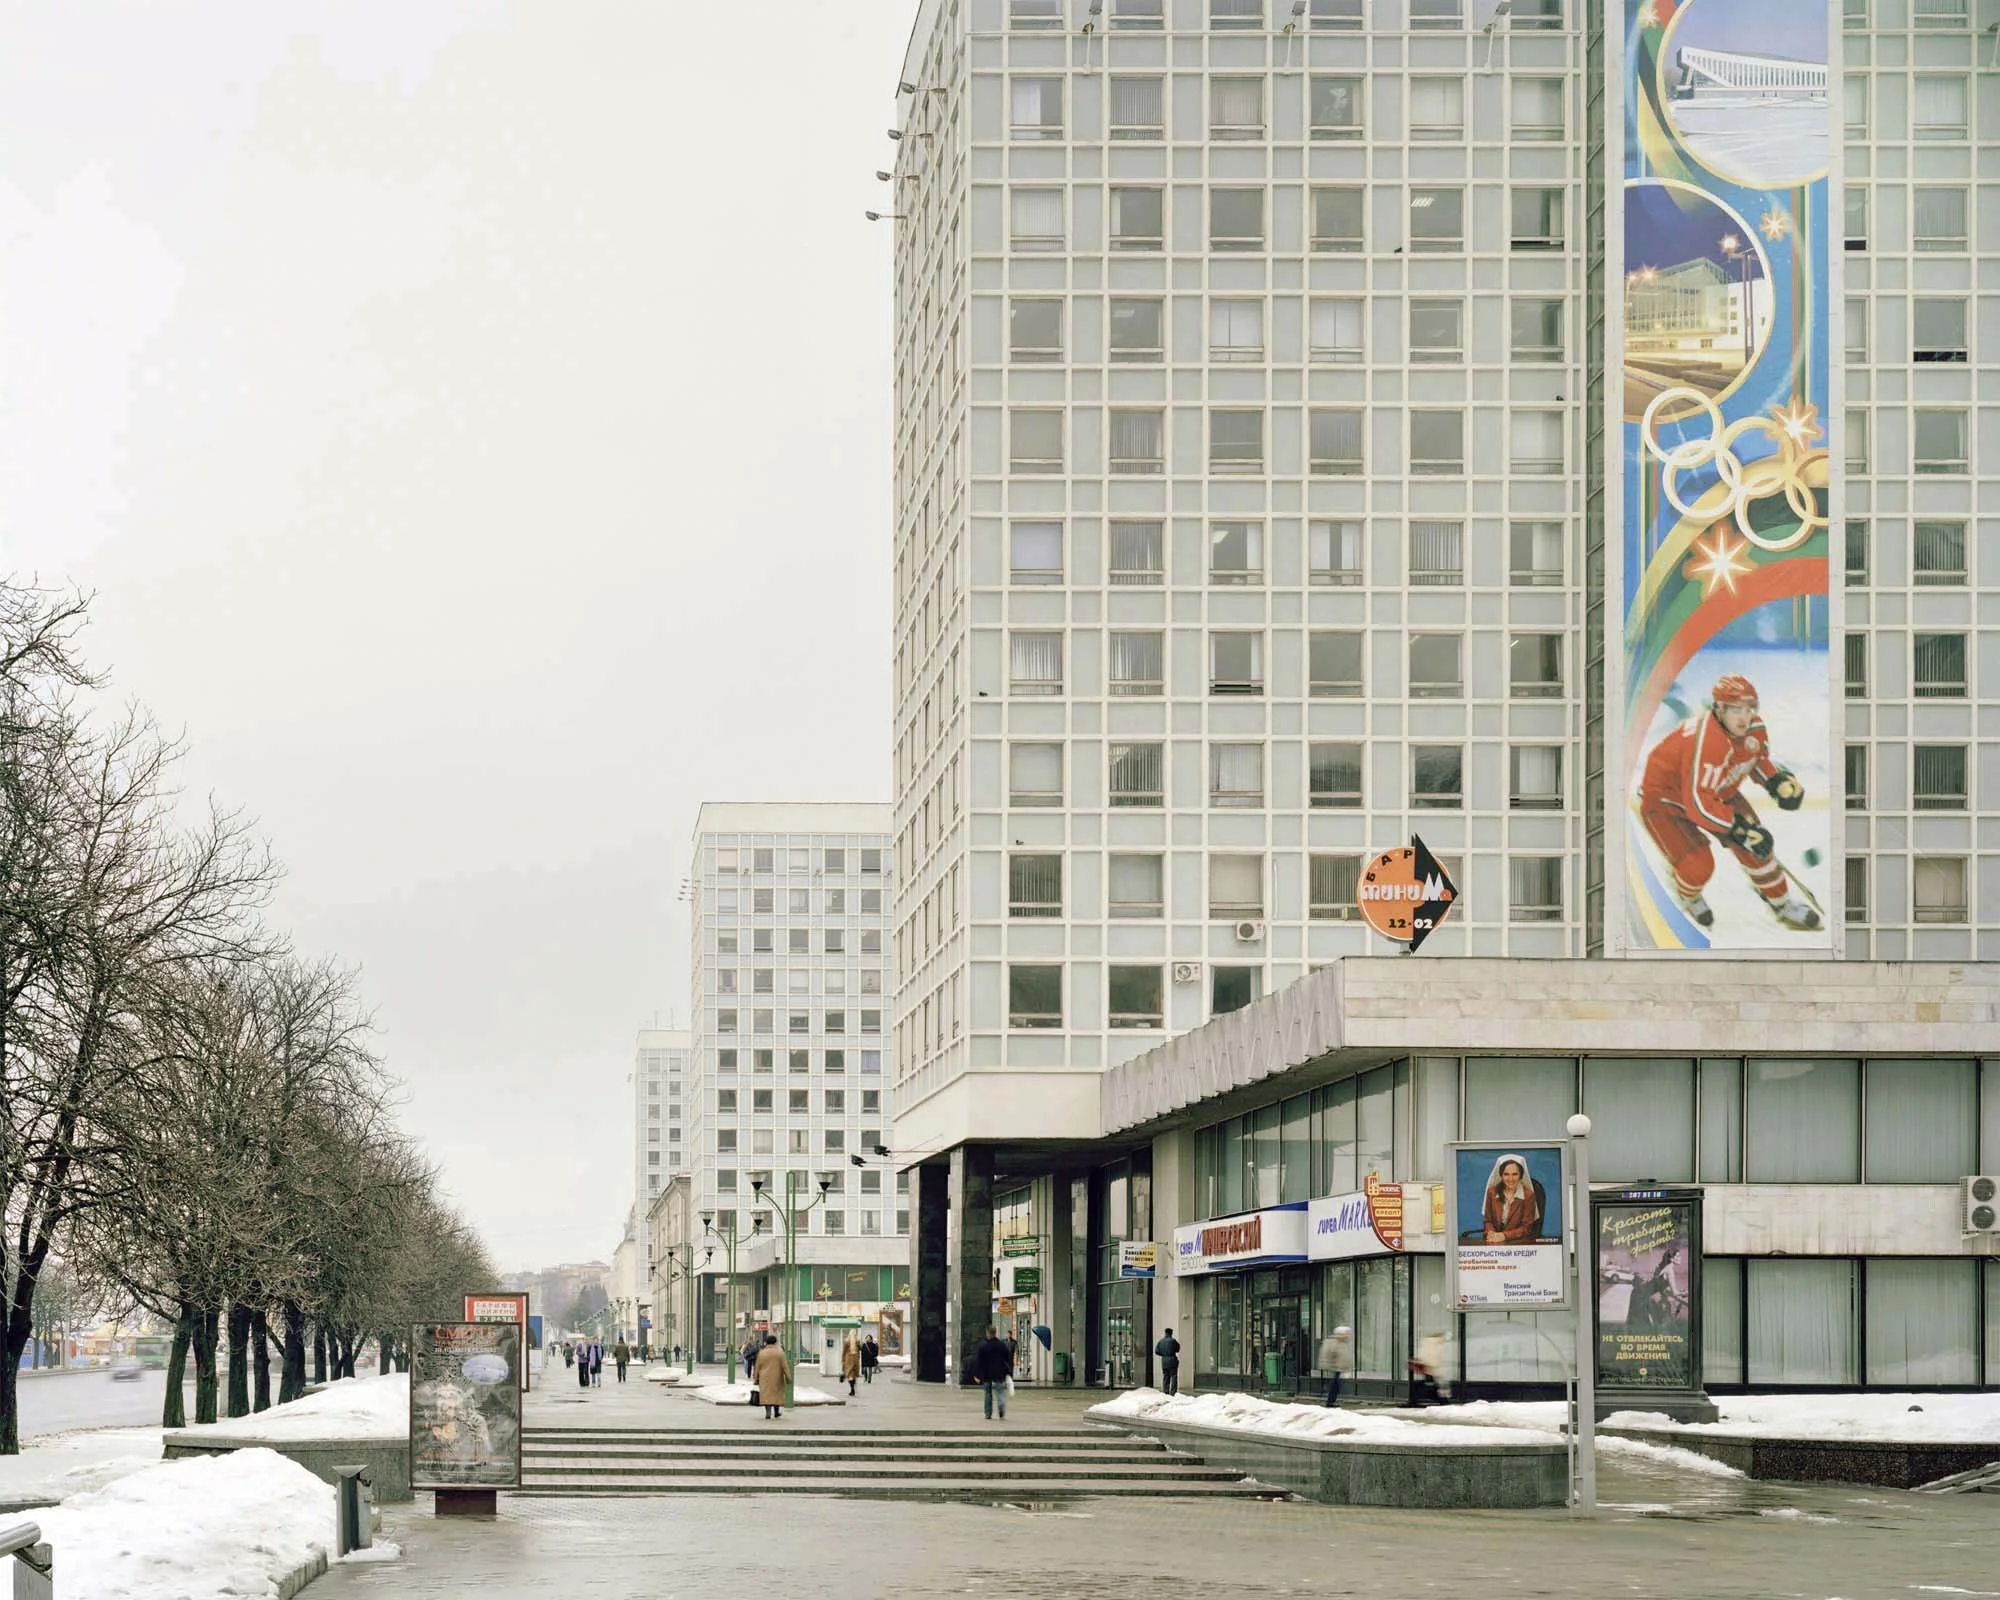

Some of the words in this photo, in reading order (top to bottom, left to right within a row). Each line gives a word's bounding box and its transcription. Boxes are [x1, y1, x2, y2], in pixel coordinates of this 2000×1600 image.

[1366, 849, 1413, 882] БАР
[1317, 1217, 1338, 1235] SUPER
[1602, 1207, 1672, 1235] Красота
[1612, 1220, 1674, 1247] требует
[1631, 1230, 1676, 1258] жертв?
[1458, 1249, 1512, 1258] БЕСКОРЫСТНЫЙ
[1513, 1249, 1537, 1258] КРЕДИТ
[1503, 1282, 1531, 1290] Минский
[1616, 1334, 1684, 1343] ОТВЛЕКАЙТЕСЬ
[1615, 1352, 1671, 1361] ДВИЖЕНИЯ!
